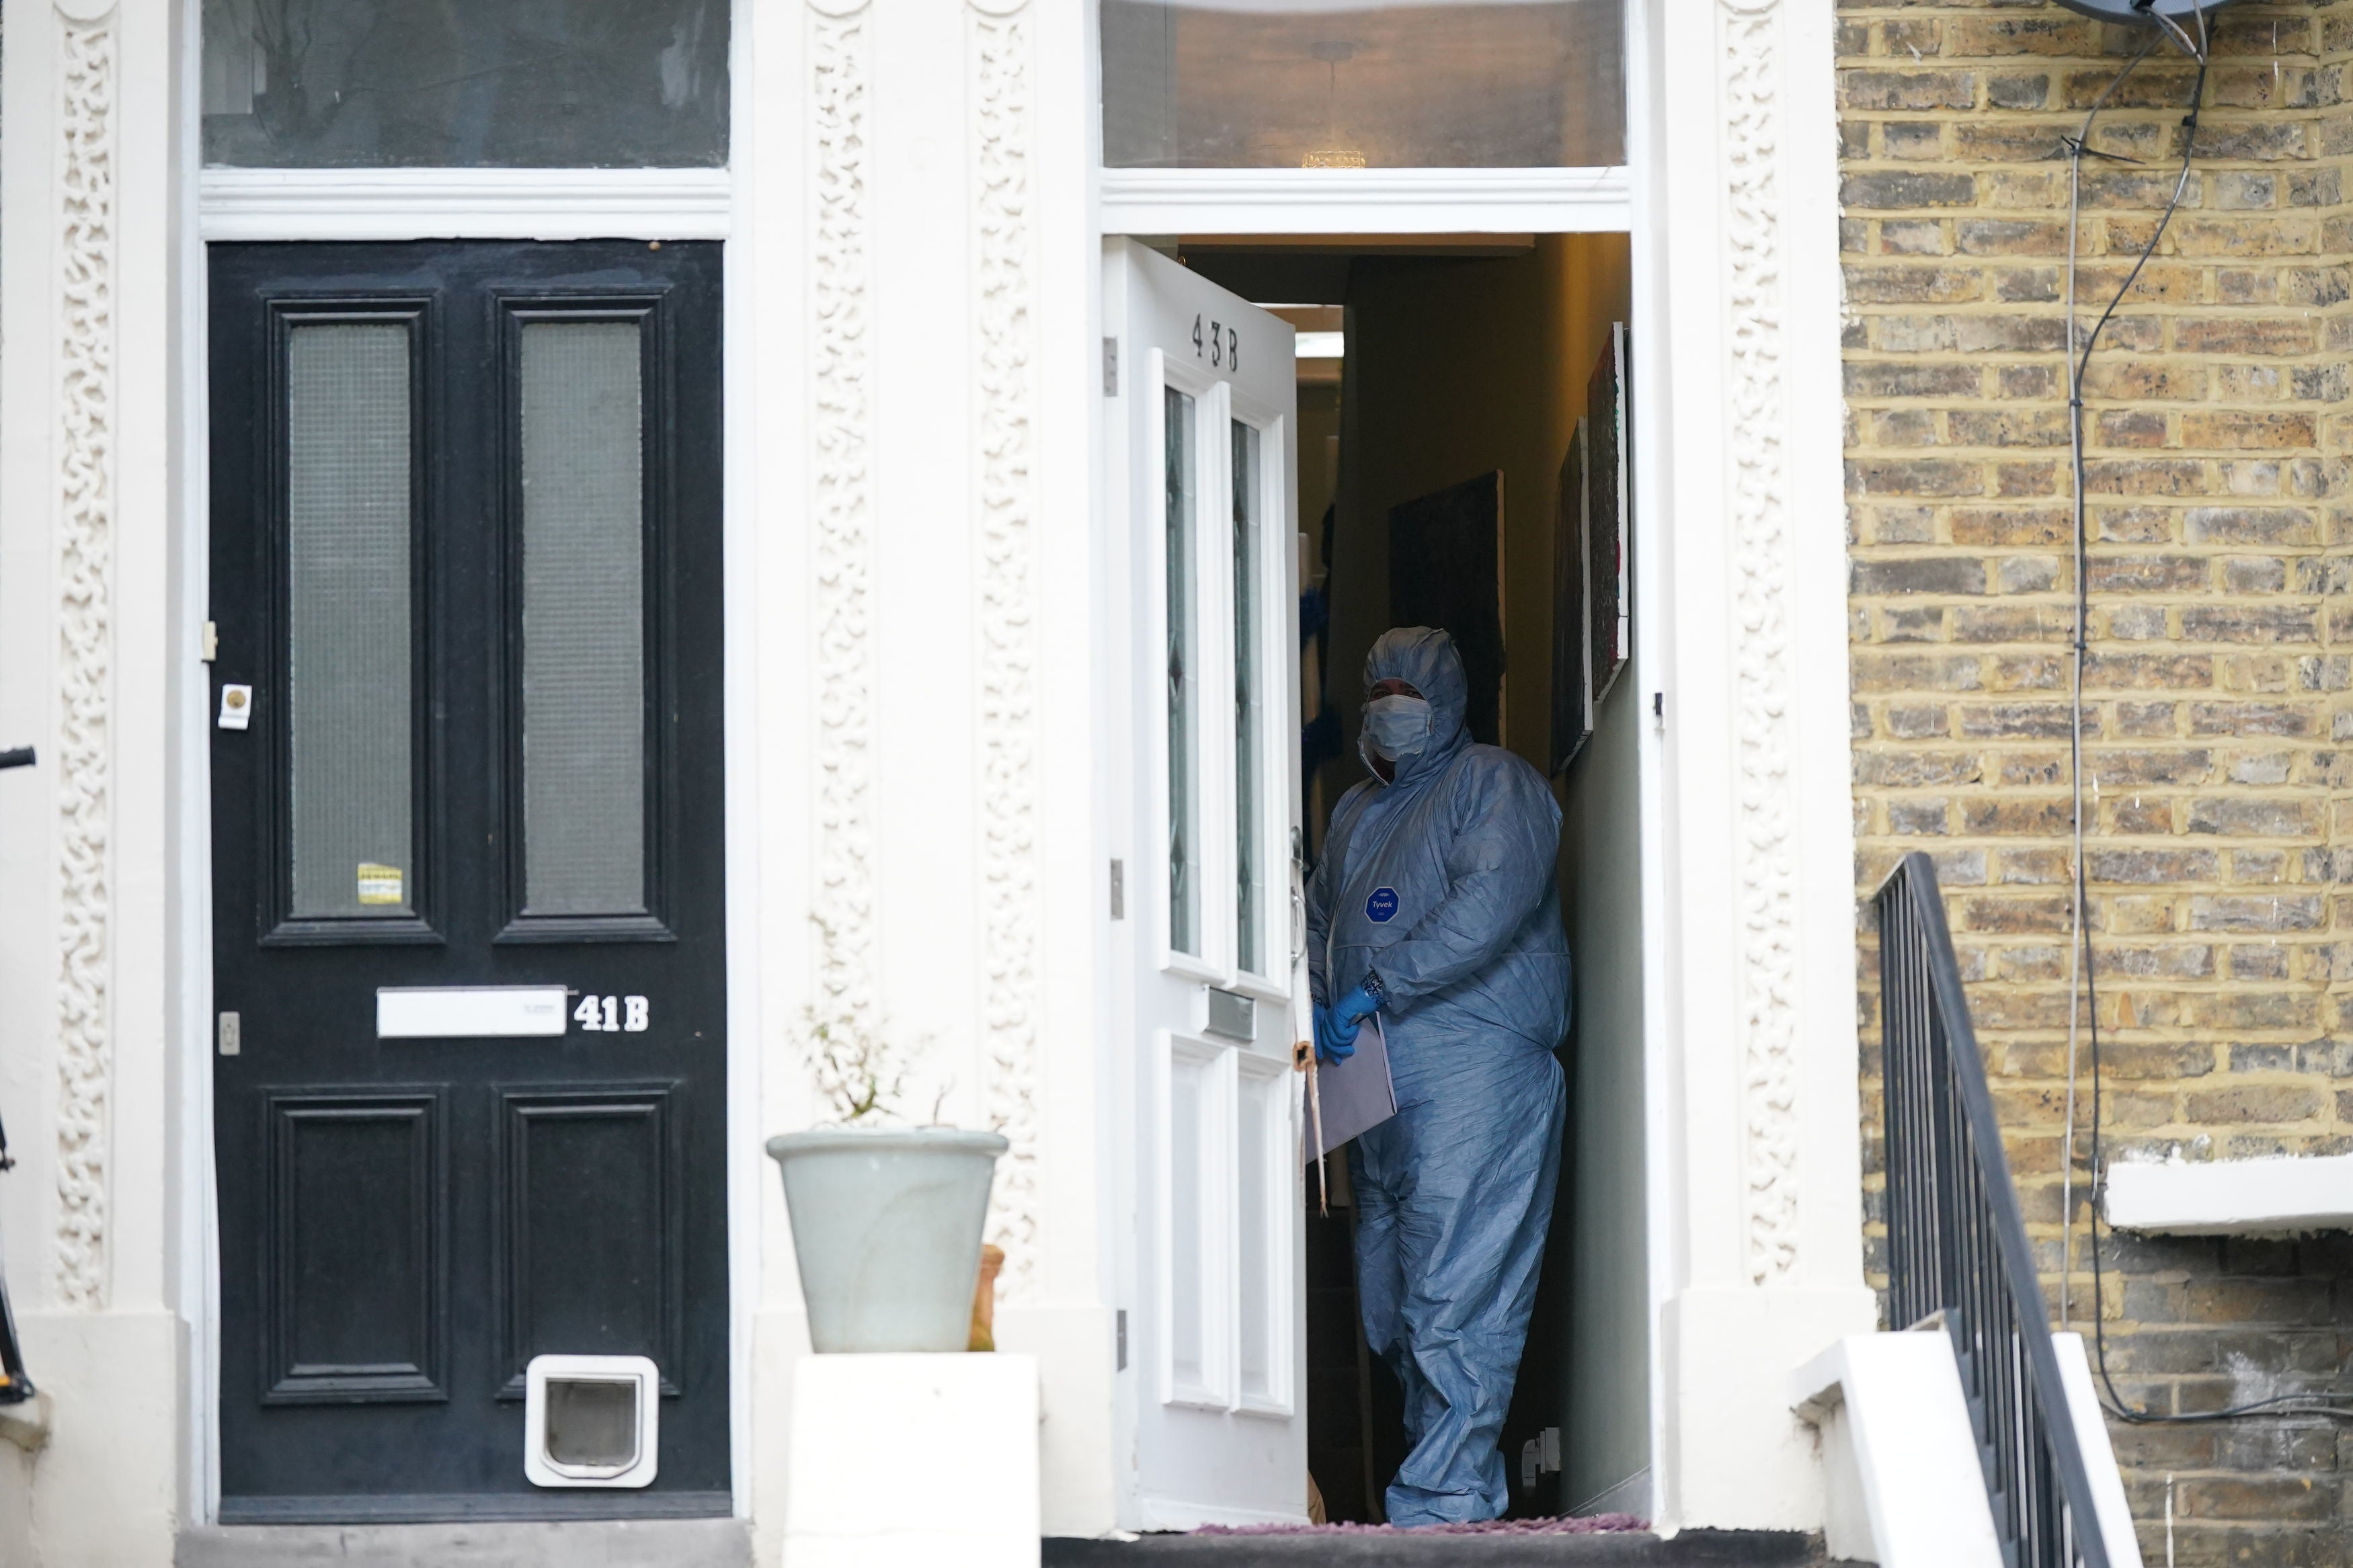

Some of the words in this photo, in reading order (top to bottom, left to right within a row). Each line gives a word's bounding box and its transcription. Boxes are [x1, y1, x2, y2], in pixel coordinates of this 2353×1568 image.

[1193, 313, 1238, 372] 43B
[1373, 901, 1392, 909] Tyvek
[573, 995, 649, 1032] 41B
